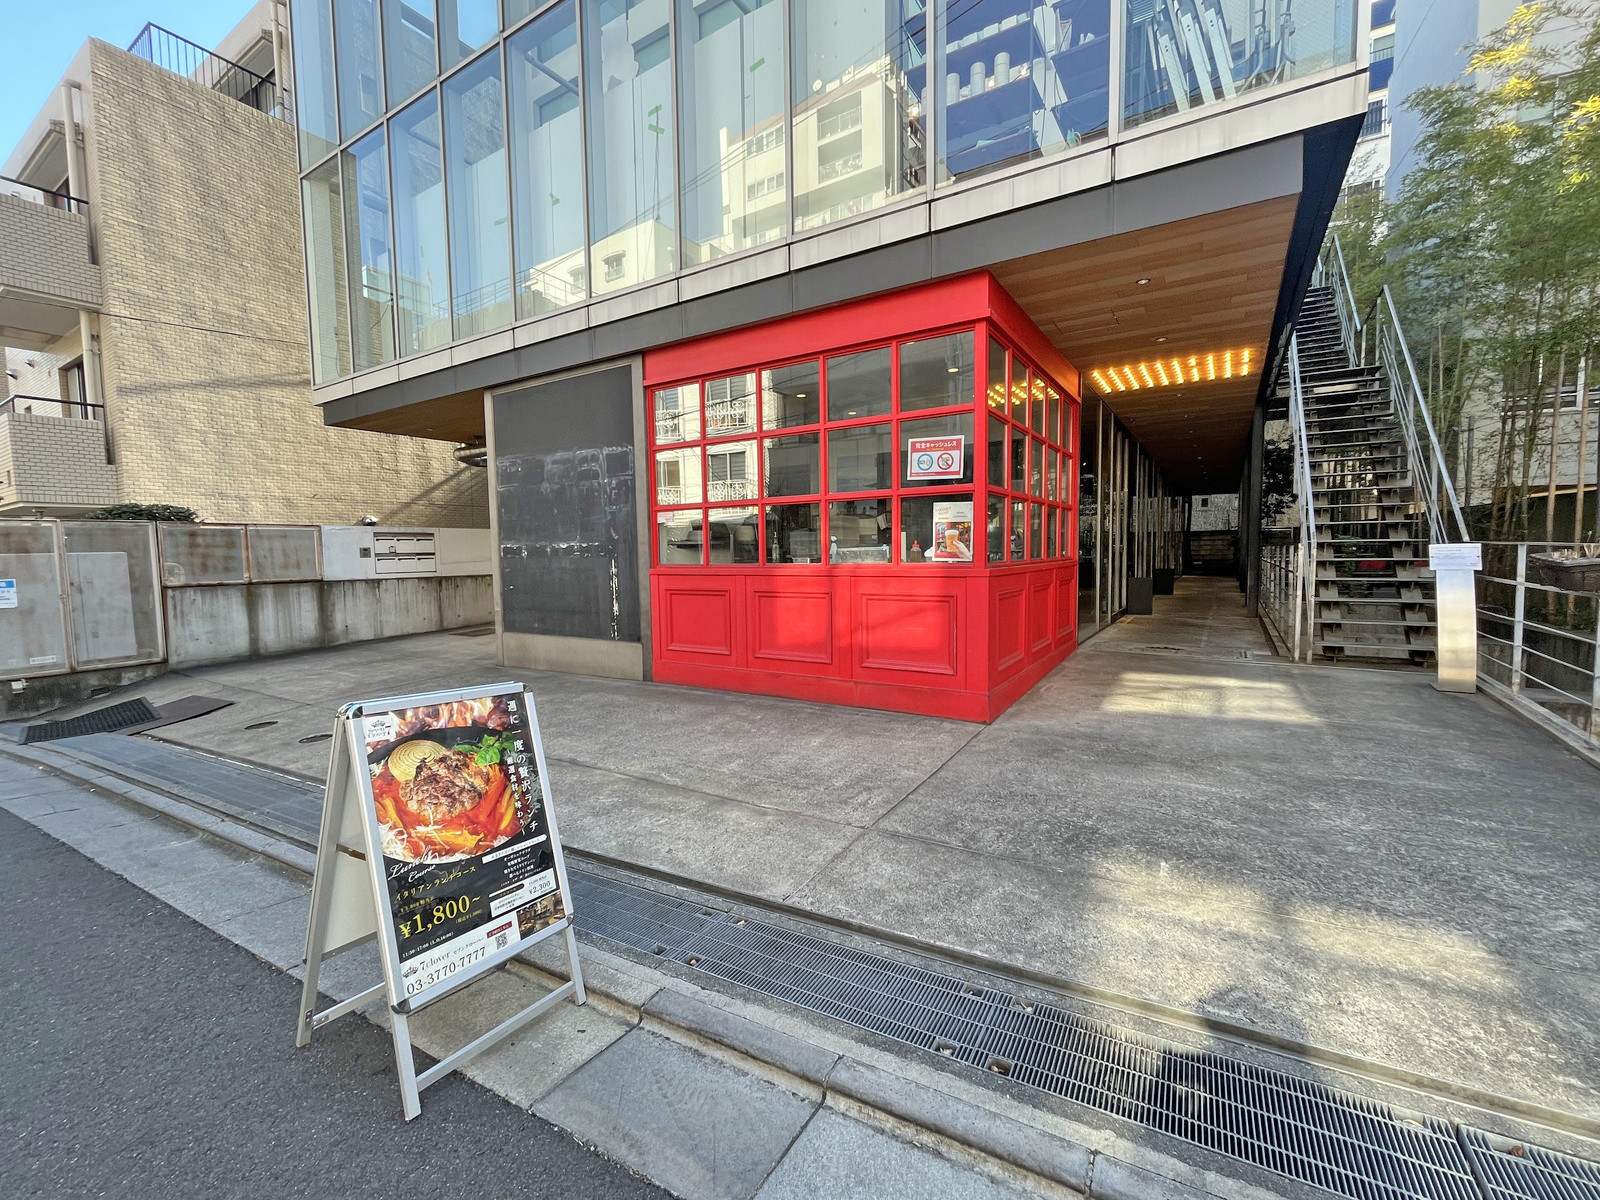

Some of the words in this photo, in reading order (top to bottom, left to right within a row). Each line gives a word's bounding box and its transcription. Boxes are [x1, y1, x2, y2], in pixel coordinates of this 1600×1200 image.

[915, 441, 957, 449] 完全キャッシュレス
[507, 700, 538, 832] 週に一度の贅沢ランチ
[396, 866, 476, 901] イタリアンランチコース
[529, 881, 551, 895] ¥2,300
[406, 946, 486, 995] 03-3770-7777
